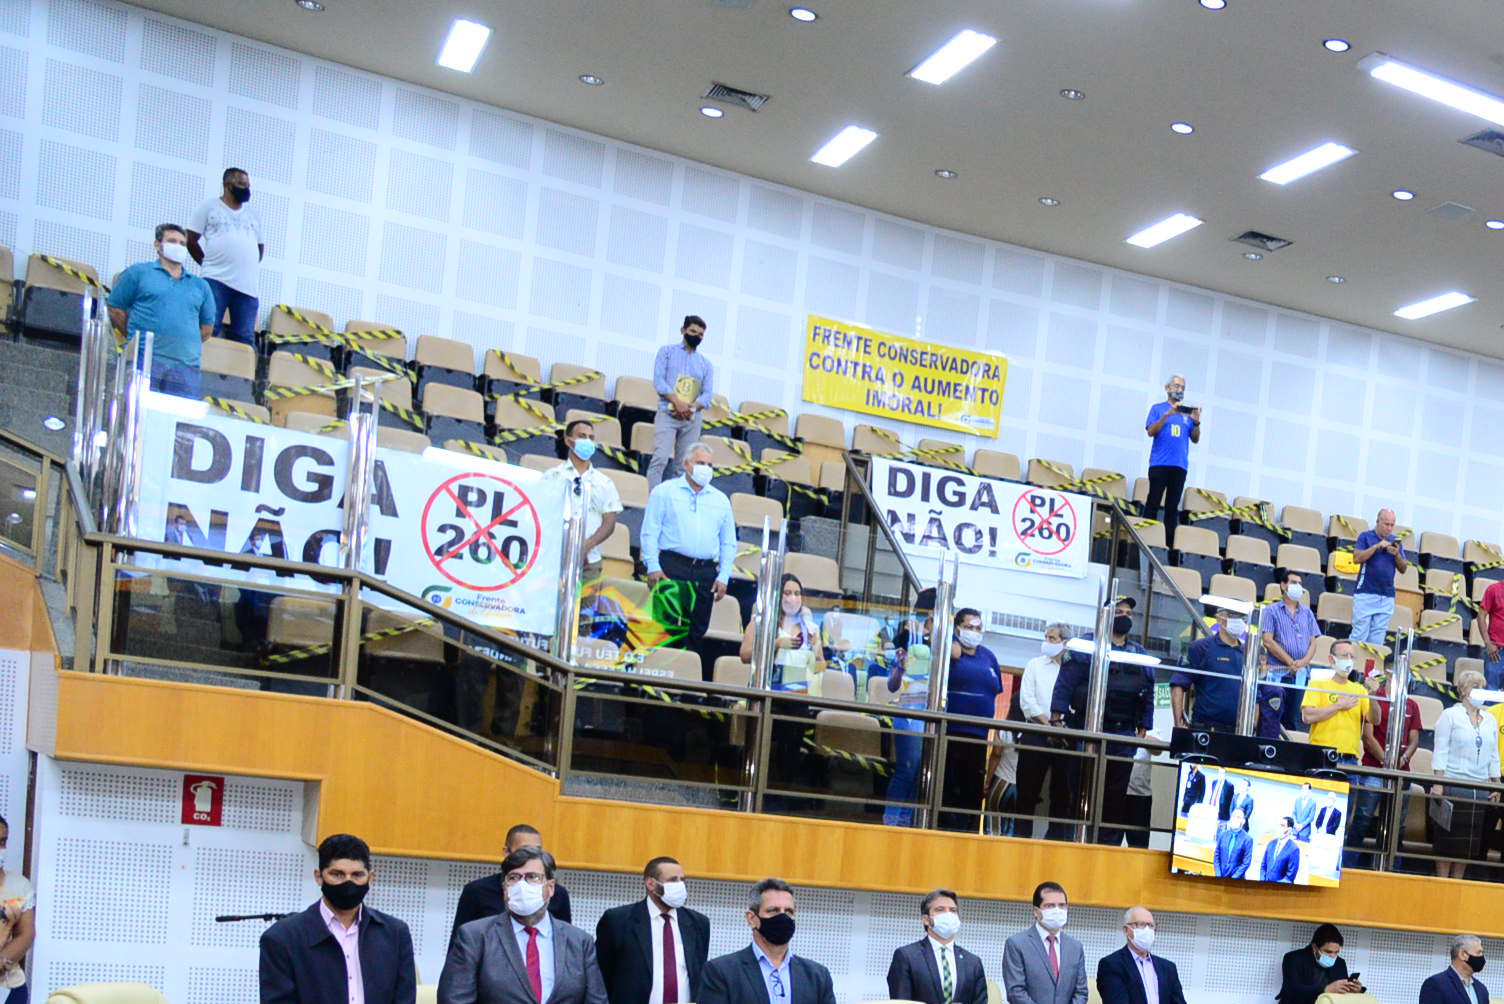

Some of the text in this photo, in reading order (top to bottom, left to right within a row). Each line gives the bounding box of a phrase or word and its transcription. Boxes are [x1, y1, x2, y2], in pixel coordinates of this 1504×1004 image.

[812, 325, 1001, 382] FRENTE CONSERVADORA
[808, 352, 1000, 407] CONTRA O AUMENTO
[865, 388, 943, 420] IMORAL!
[170, 421, 400, 518] DIGA
[887, 465, 1001, 515] DIGA
[454, 483, 519, 528] PL
[1019, 517, 1071, 543] 260
[1029, 494, 1064, 518] PL
[434, 523, 530, 571] 260
[886, 508, 998, 558] NÃO!
